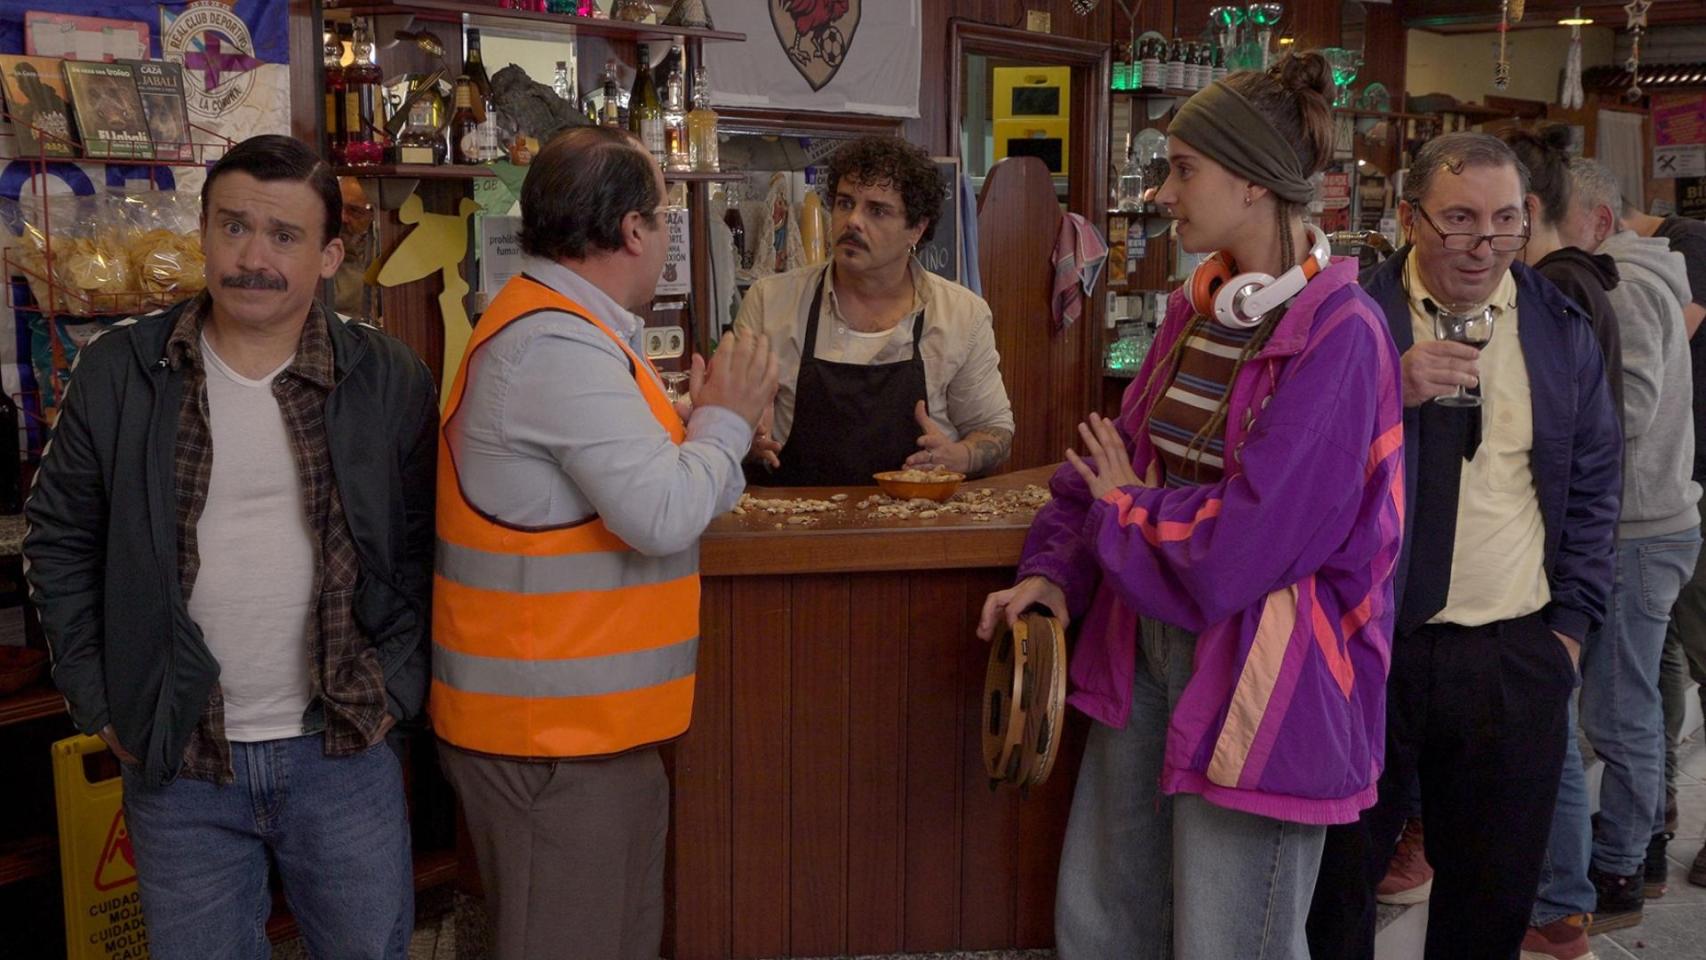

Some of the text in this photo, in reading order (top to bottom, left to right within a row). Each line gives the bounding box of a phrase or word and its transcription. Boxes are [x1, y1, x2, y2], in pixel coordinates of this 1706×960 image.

[171, 12, 248, 49] REAL CLUB DEPORTIVO
[140, 66, 162, 75] CAZA
[199, 96, 208, 111] LA
[496, 246, 519, 255] fumar
[105, 929, 146, 953] MOLH
